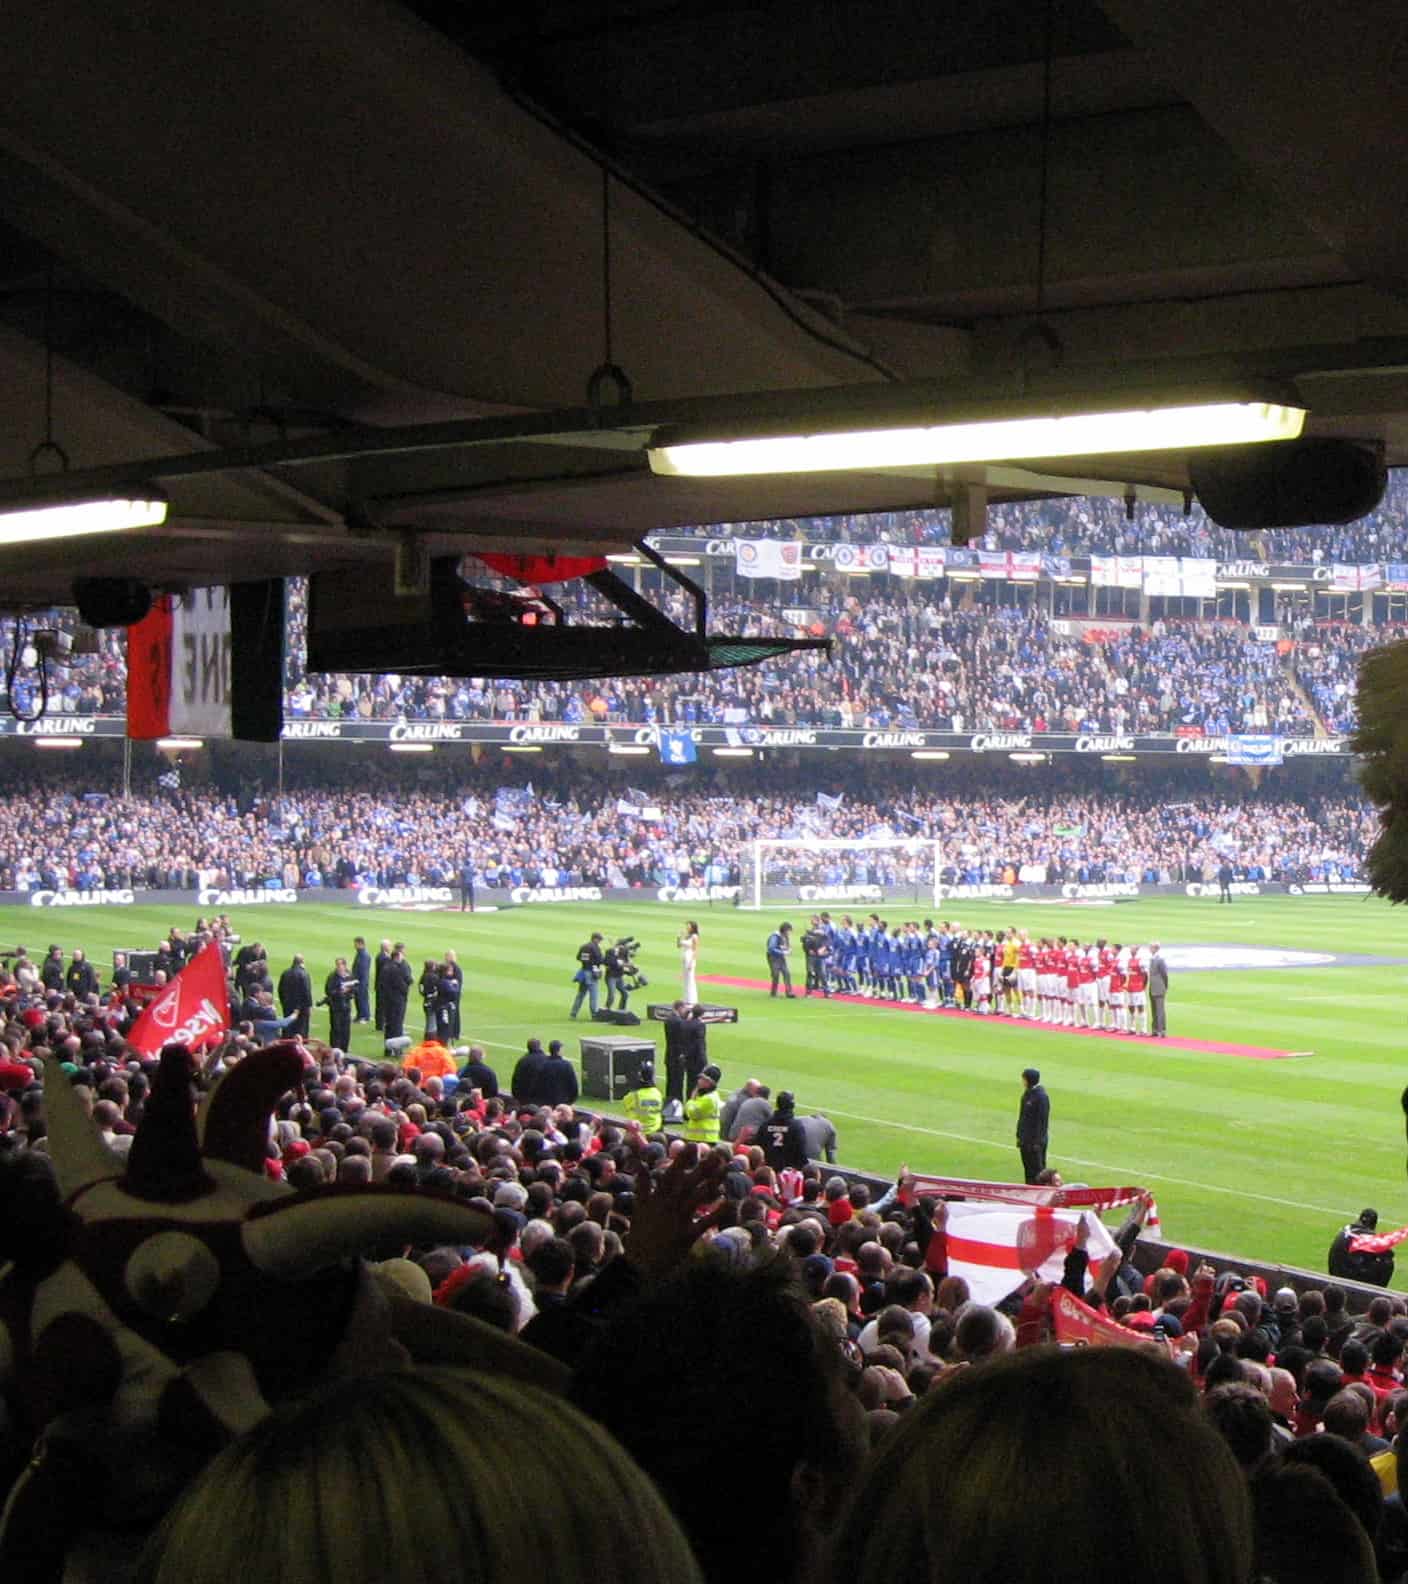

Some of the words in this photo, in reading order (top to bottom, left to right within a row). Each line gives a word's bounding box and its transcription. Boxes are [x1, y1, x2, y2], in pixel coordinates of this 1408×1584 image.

[1216, 562, 1270, 577] ARLING
[16, 718, 96, 735] CARLING
[283, 723, 341, 737] ARLING
[389, 724, 461, 741] CARLING
[510, 726, 579, 742] CARLING
[863, 732, 925, 748] CARLING
[970, 734, 1032, 750] CARLING
[1075, 736, 1135, 752] CARLING
[1176, 737, 1228, 753] CARLIN
[31, 889, 134, 906] CARLING
[198, 888, 297, 905] CARLING
[358, 887, 452, 904] CARLING
[511, 886, 602, 903] CARLING
[773, 1133, 784, 1147] 2
